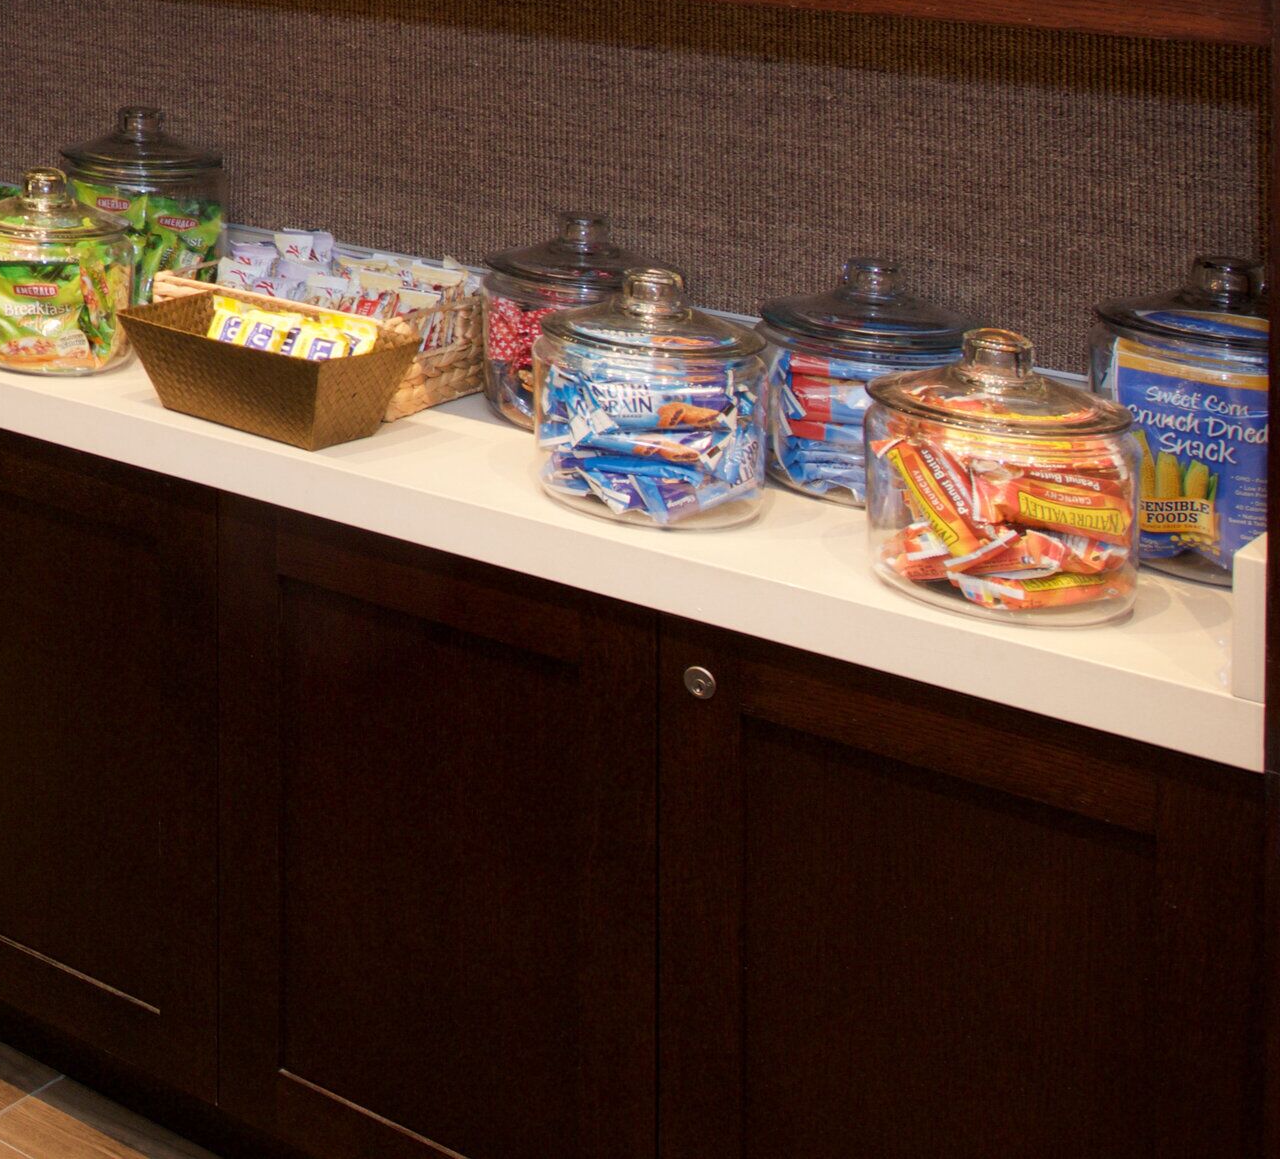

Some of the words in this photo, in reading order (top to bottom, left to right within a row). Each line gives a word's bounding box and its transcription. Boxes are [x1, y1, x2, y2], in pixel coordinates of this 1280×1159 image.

[16, 286, 56, 295] EMERALD
[4, 301, 71, 316] Breakfast
[1145, 386, 1201, 410] Sweet
[1127, 403, 1201, 434] Crunch
[1207, 416, 1268, 444] Dried
[1159, 433, 1237, 464] Snack
[921, 449, 944, 480] Butter
[913, 470, 944, 511] CRUNCHY
[1066, 476, 1101, 491] Peanut
[941, 480, 969, 515] Peanut
[1045, 491, 1092, 505] CRUNCHY
[1071, 512, 1119, 533] NATURE
[1147, 513, 1197, 523] FOODS
